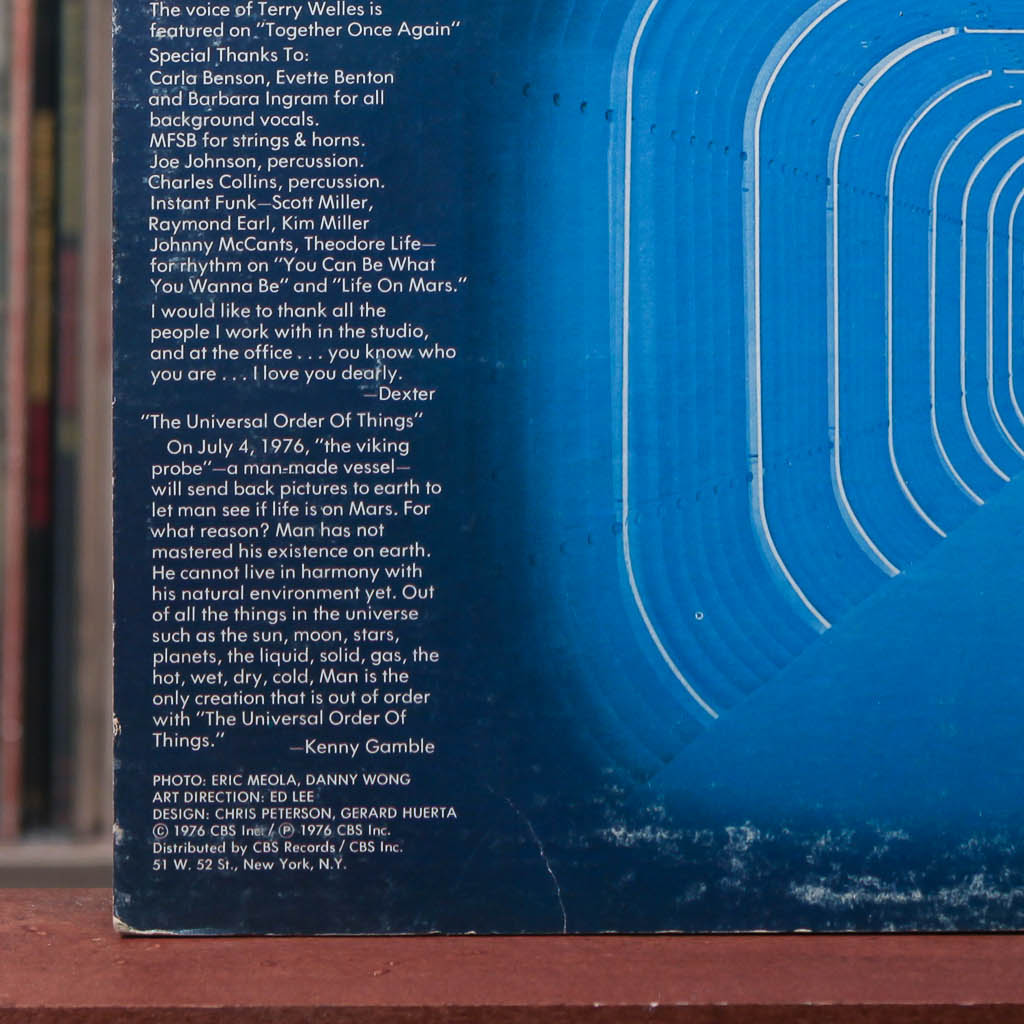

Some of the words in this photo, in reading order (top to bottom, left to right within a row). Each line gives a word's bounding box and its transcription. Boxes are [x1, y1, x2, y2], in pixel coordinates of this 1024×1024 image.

[150, 22, 224, 38] featured
[229, 27, 250, 37] on
[257, 21, 342, 40] "Together
[348, 22, 392, 37] Once
[397, 21, 460, 40] Again"
[149, 48, 210, 66] Special
[216, 47, 278, 63] Thanks
[283, 47, 308, 62] To:
[149, 69, 198, 89] Carla
[202, 69, 270, 87] Benson,
[275, 69, 328, 84] Evette
[334, 68, 393, 84] Benton
[149, 131, 197, 148] MFSB
[201, 130, 228, 147] for
[232, 132, 289, 151] strings
[293, 131, 306, 147] &
[311, 130, 365, 147] horns.
[148, 174, 213, 190] Charles
[219, 173, 282, 191] Collins,
[289, 174, 385, 192] percussion.
[140, 412, 181, 429] "The
[186, 412, 267, 429] Universal
[272, 411, 325, 428] Order
[329, 411, 352, 428] Of
[355, 411, 423, 431] Things"
[152, 584, 176, 601] his
[181, 583, 244, 600] natural
[249, 584, 360, 600] environment
[364, 585, 396, 604] yet.
[401, 583, 435, 600] Out
[152, 647, 222, 668] planets,
[226, 646, 254, 663] the
[259, 645, 314, 667] liquid,
[319, 645, 365, 664] solid,
[370, 650, 407, 666] gas,
[412, 645, 439, 662] the
[151, 731, 224, 751] Things."
[365, 737, 435, 754] Gamble
[152, 773, 206, 786] PHOTO:
[211, 773, 242, 786] ERIC
[246, 773, 300, 787] MEOLA,
[305, 773, 358, 785] DANNY
[362, 772, 411, 786] WONG
[151, 790, 179, 803] ART
[183, 790, 264, 803] DIRECTION:
[269, 789, 287, 802] ED
[292, 789, 314, 802] LEE
[152, 807, 209, 820] DESIGN:
[214, 807, 256, 820] CHRIS
[261, 806, 335, 820] PETERSON,
[340, 805, 397, 819] GERARD
[402, 805, 457, 819] HUERTA
[153, 859, 166, 870] 51
[174, 858, 191, 871] W.
[197, 858, 212, 870] 52
[218, 858, 238, 871] St.,
[244, 859, 274, 870] New
[280, 858, 313, 871] York,
[319, 856, 346, 869] N.Y.
